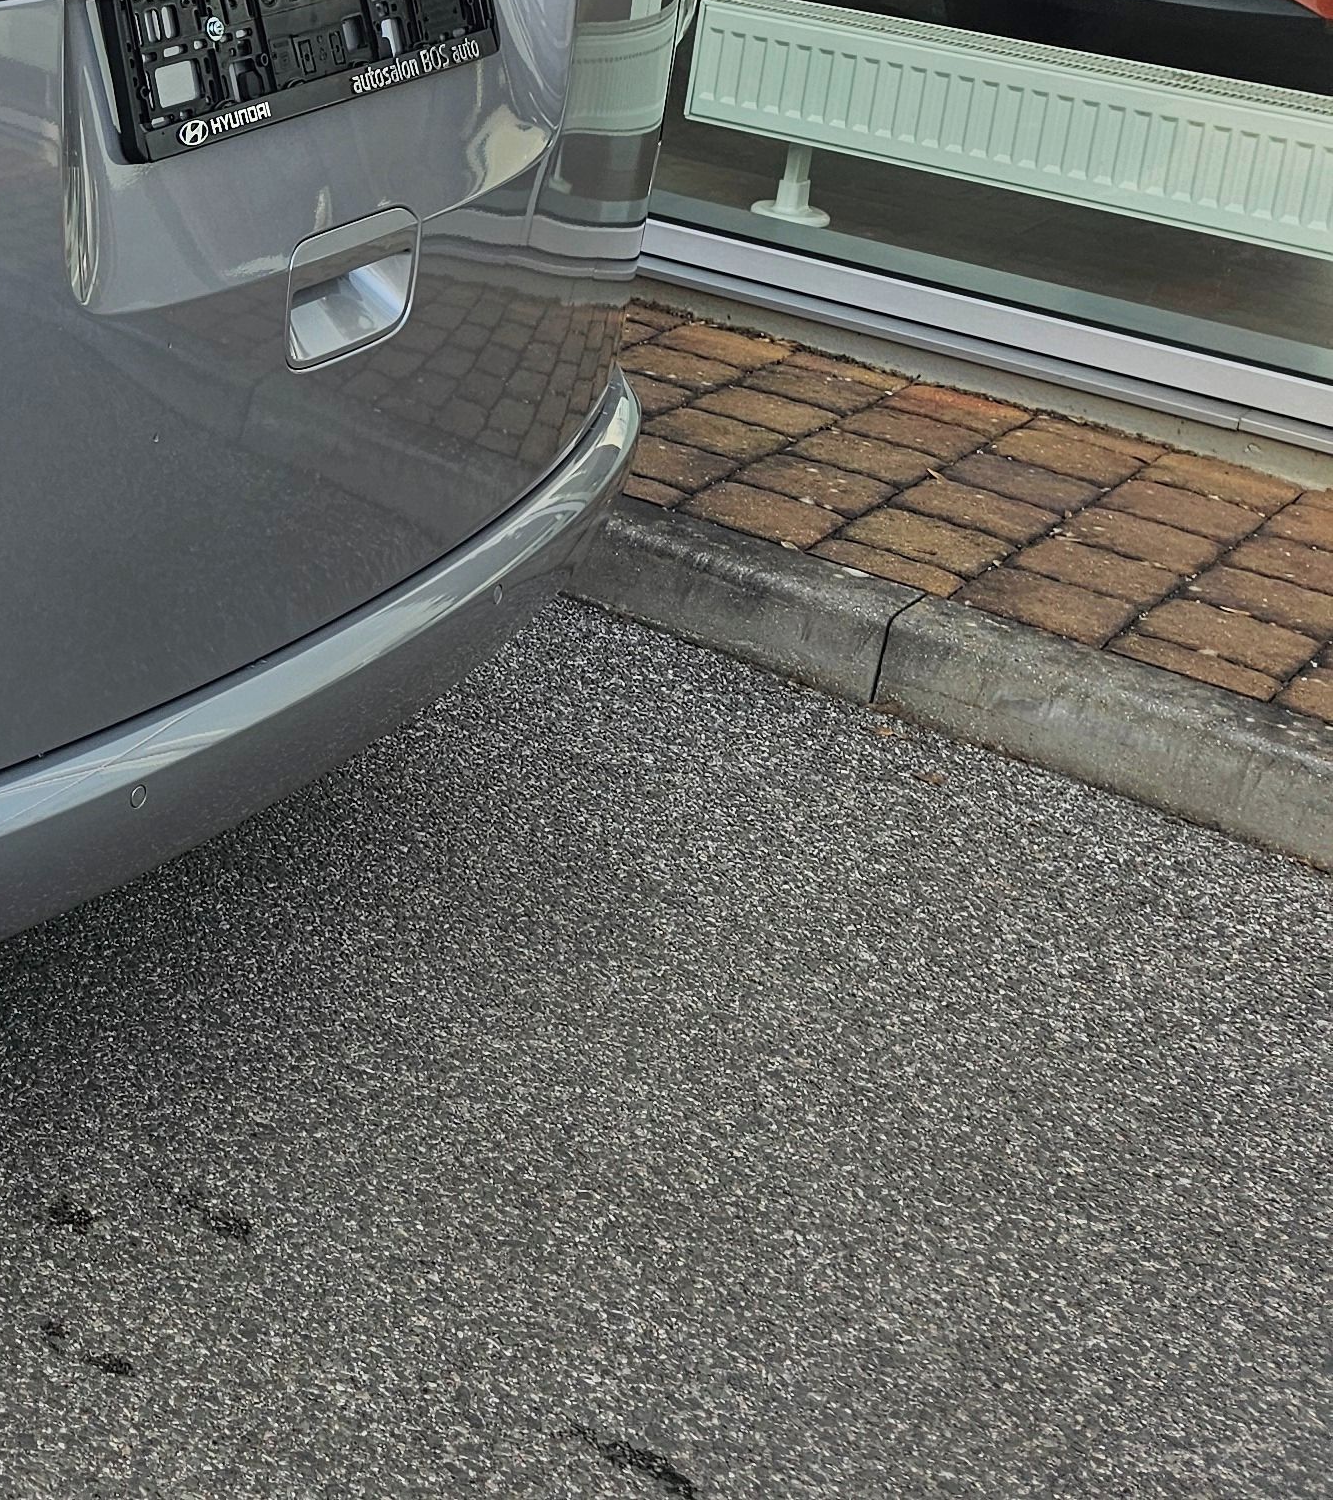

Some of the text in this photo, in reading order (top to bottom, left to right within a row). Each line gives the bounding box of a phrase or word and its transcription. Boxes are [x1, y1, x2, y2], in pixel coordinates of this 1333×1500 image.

[352, 37, 480, 94] autosalon BOS auto
[210, 102, 272, 135] HYUNDAI
